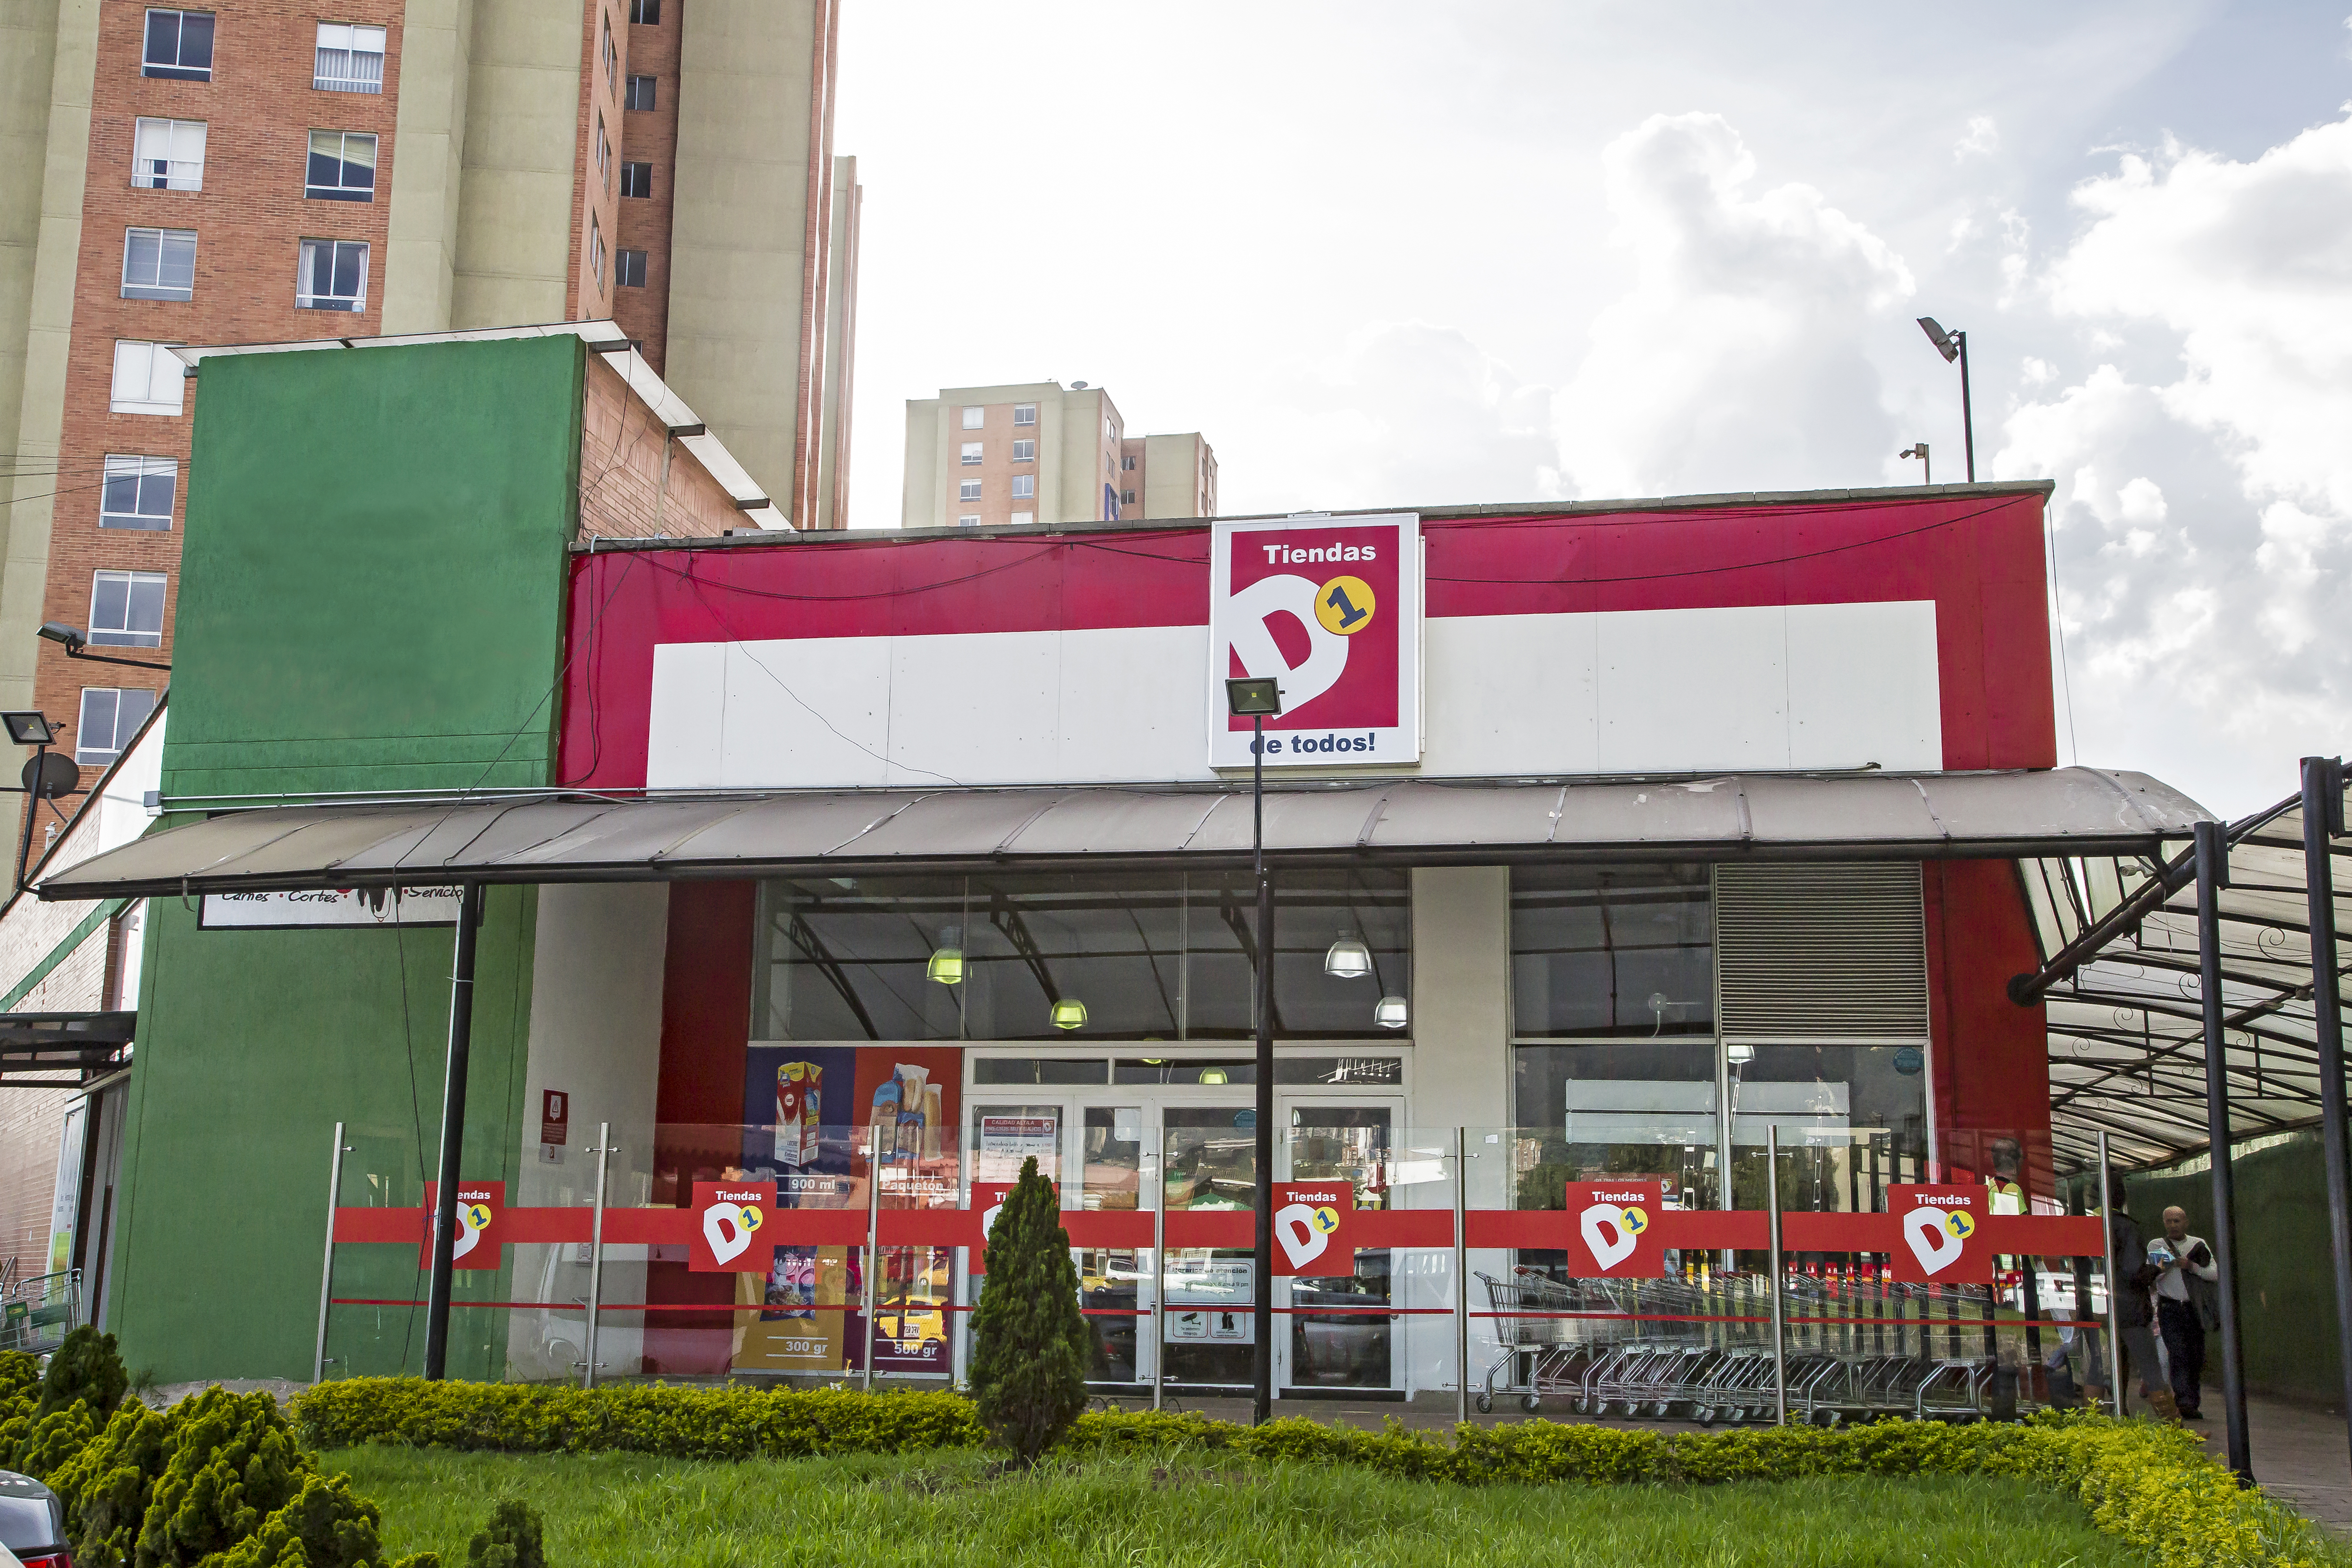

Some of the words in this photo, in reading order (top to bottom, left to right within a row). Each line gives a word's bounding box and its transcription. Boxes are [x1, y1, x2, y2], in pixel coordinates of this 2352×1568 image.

[1263, 543, 1376, 565] Tiendas
[1291, 733, 1375, 753] todos!
[288, 890, 339, 903] Cortes
[792, 1179, 816, 1189] 900
[820, 1179, 835, 1189] ml
[458, 1190, 490, 1199] endas
[715, 1191, 762, 1201] Tiendas
[1286, 1192, 1337, 1202] Tiendas
[1591, 1191, 1645, 1202] Tiendas
[1915, 1194, 1971, 1205] Tiendas
[703, 1202, 759, 1265] D1
[1275, 1203, 1335, 1270] D1
[1581, 1203, 1644, 1271] D1
[1903, 1206, 1971, 1276] D1
[786, 1341, 810, 1352] 300
[813, 1343, 828, 1355] gr
[894, 1343, 918, 1355] 500
[923, 1346, 937, 1358] gr
